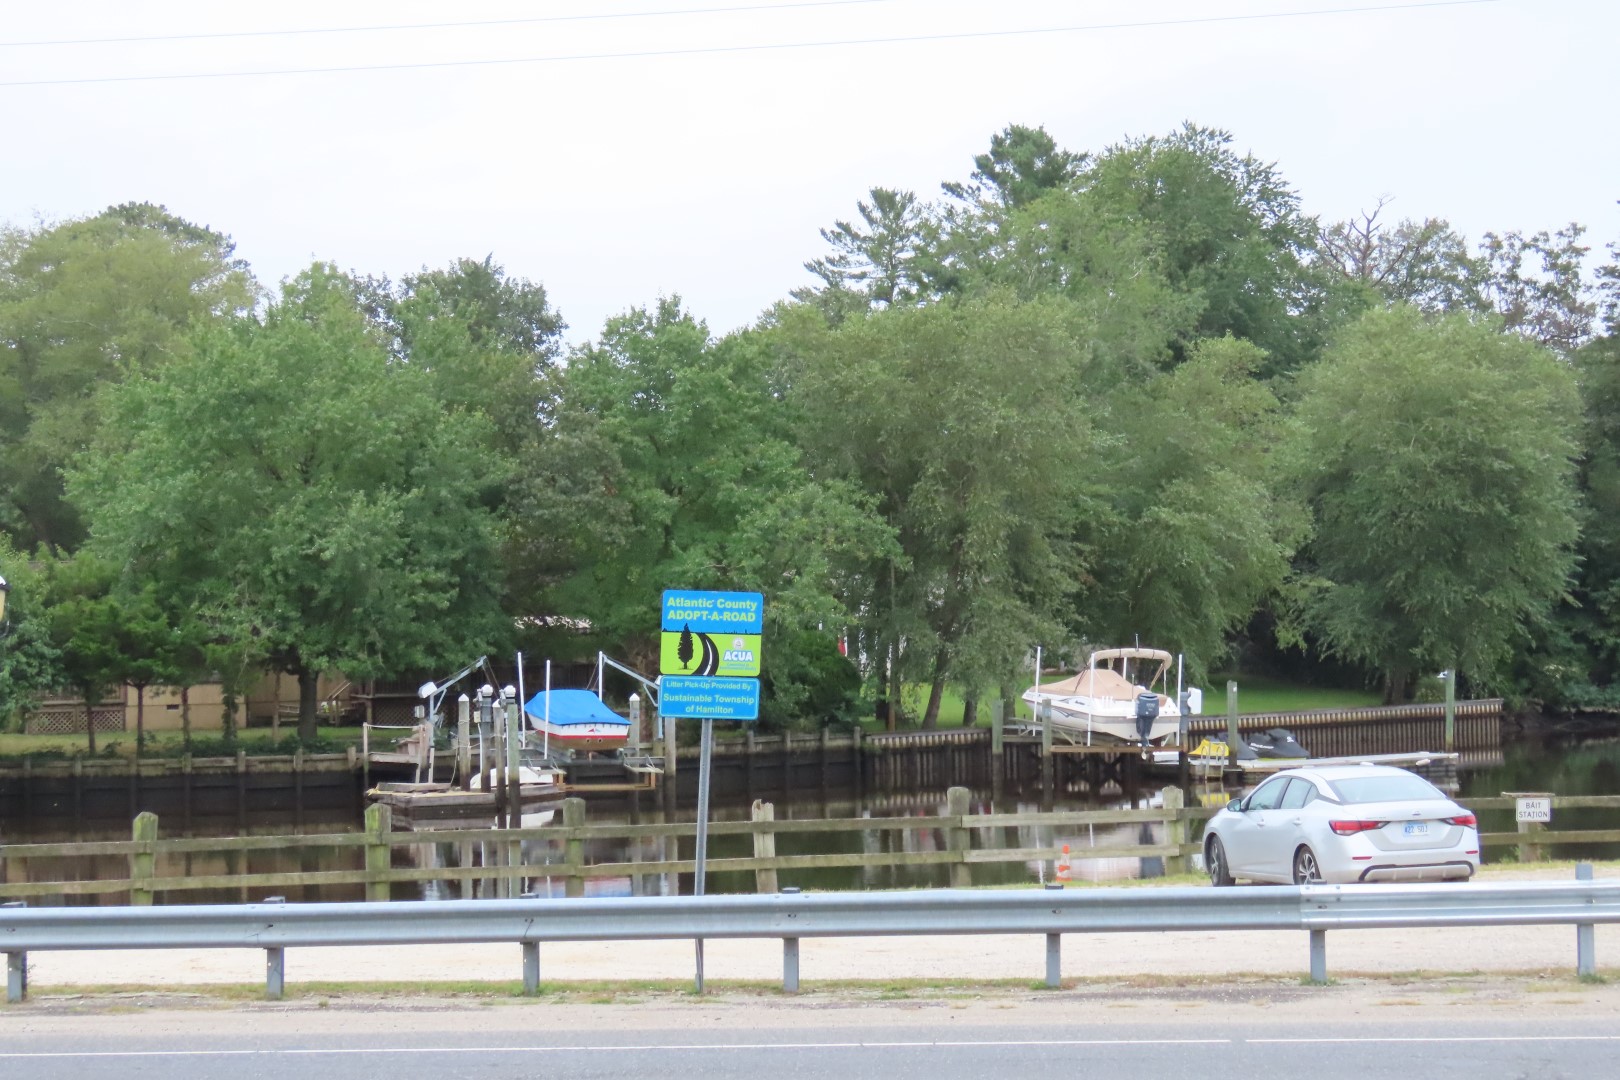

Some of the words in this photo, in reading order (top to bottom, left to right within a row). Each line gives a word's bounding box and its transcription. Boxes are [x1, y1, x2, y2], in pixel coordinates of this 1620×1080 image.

[667, 597, 713, 608] Atlantic
[717, 598, 757, 611] County
[667, 610, 756, 621] ADOPT-A-ROAD
[723, 650, 753, 662] ACUA
[666, 680, 683, 688] Litter
[684, 681, 710, 690] Pick-Up
[711, 682, 741, 690] Provided
[742, 683, 753, 692] By:
[663, 693, 712, 703] Sustainable
[714, 694, 755, 705] Township
[685, 705, 694, 713] of
[696, 705, 734, 714] Hamilton
